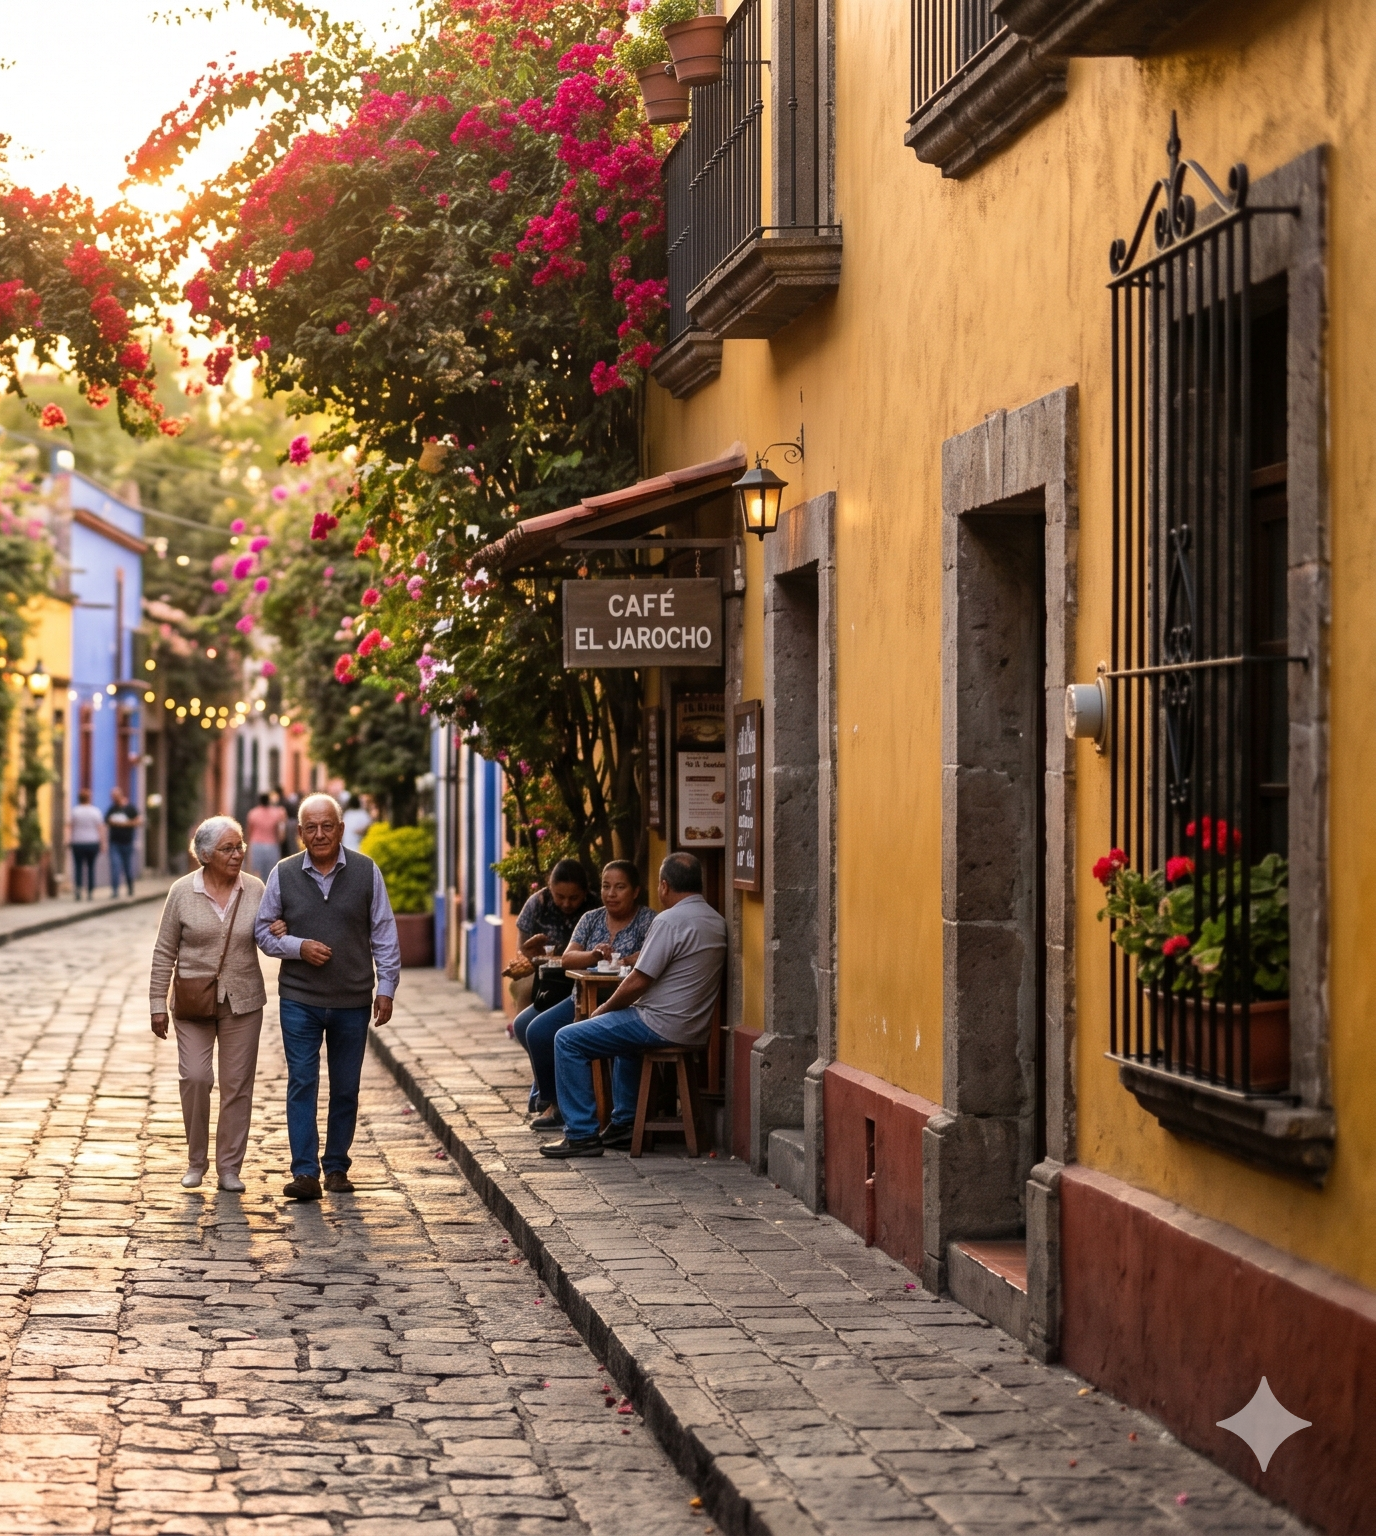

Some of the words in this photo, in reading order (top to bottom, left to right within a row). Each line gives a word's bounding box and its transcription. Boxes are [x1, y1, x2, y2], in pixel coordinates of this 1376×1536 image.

[608, 588, 675, 617] CAFÉ
[575, 627, 604, 650] EL
[608, 626, 712, 650] JAROCHO
